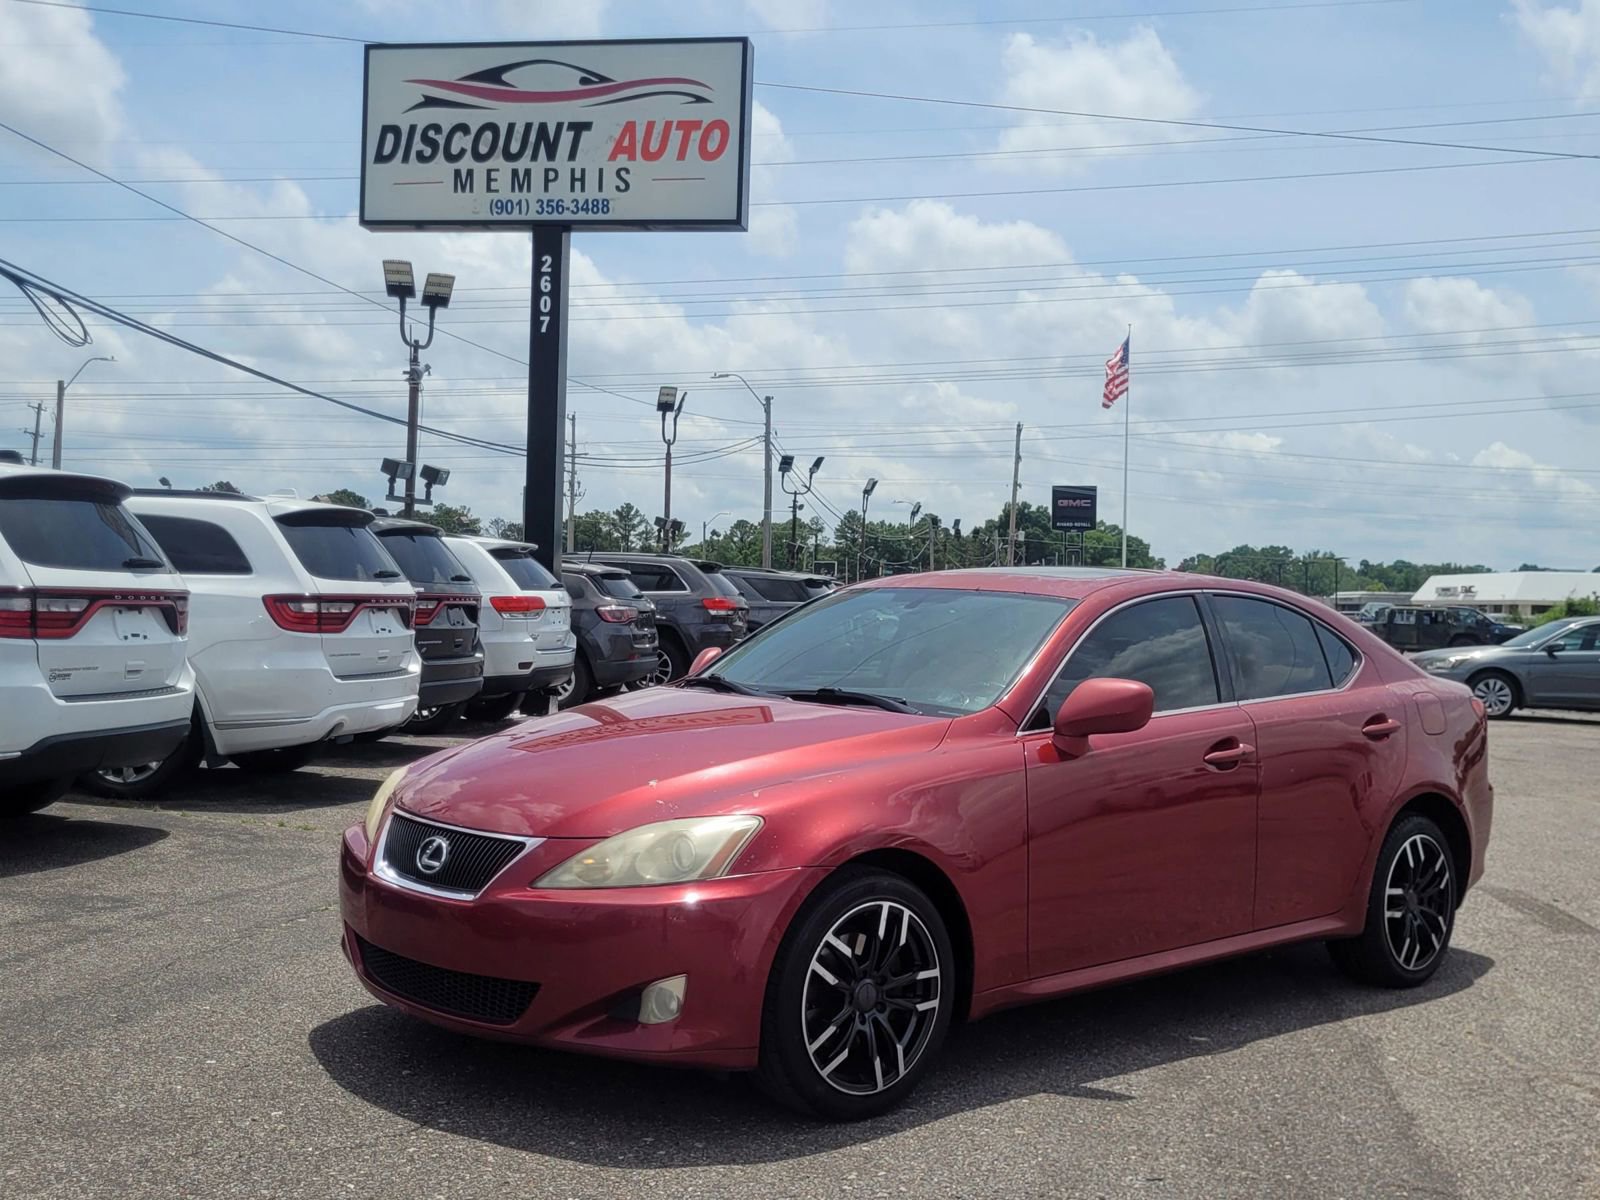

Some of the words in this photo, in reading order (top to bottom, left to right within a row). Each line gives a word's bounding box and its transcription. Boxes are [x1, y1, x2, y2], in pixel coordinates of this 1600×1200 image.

[373, 121, 593, 164] DISCOUNT
[608, 118, 730, 162] AUTO
[453, 167, 631, 193] MEMPHIS
[489, 199, 530, 216] (901)
[535, 198, 611, 215] 356-3488
[539, 255, 552, 333] 2607
[1057, 499, 1092, 507] GMC
